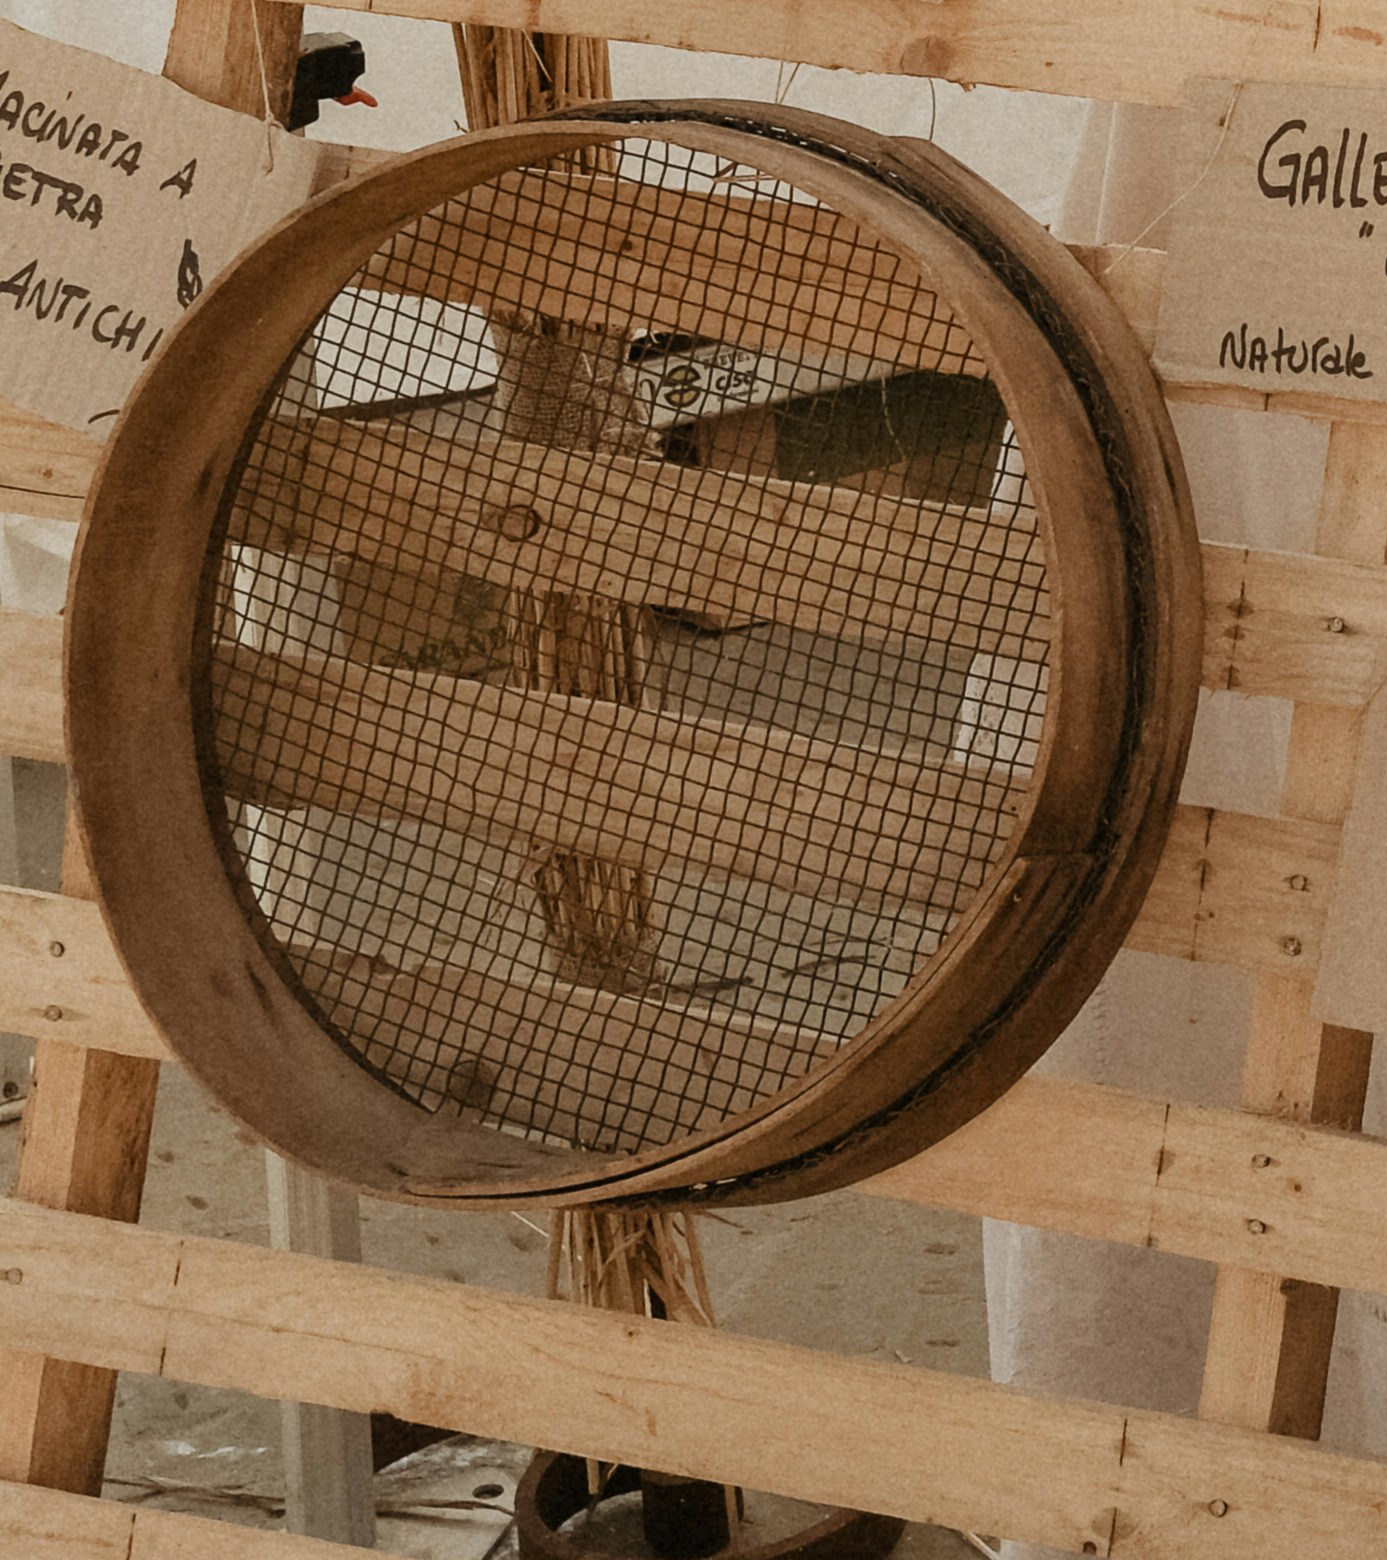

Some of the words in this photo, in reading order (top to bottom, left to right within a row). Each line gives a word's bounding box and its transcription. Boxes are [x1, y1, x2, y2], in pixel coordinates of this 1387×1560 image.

[0, 161, 104, 229] ETRA
[160, 158, 198, 199] A
[0, 258, 164, 361] ANTICHI
